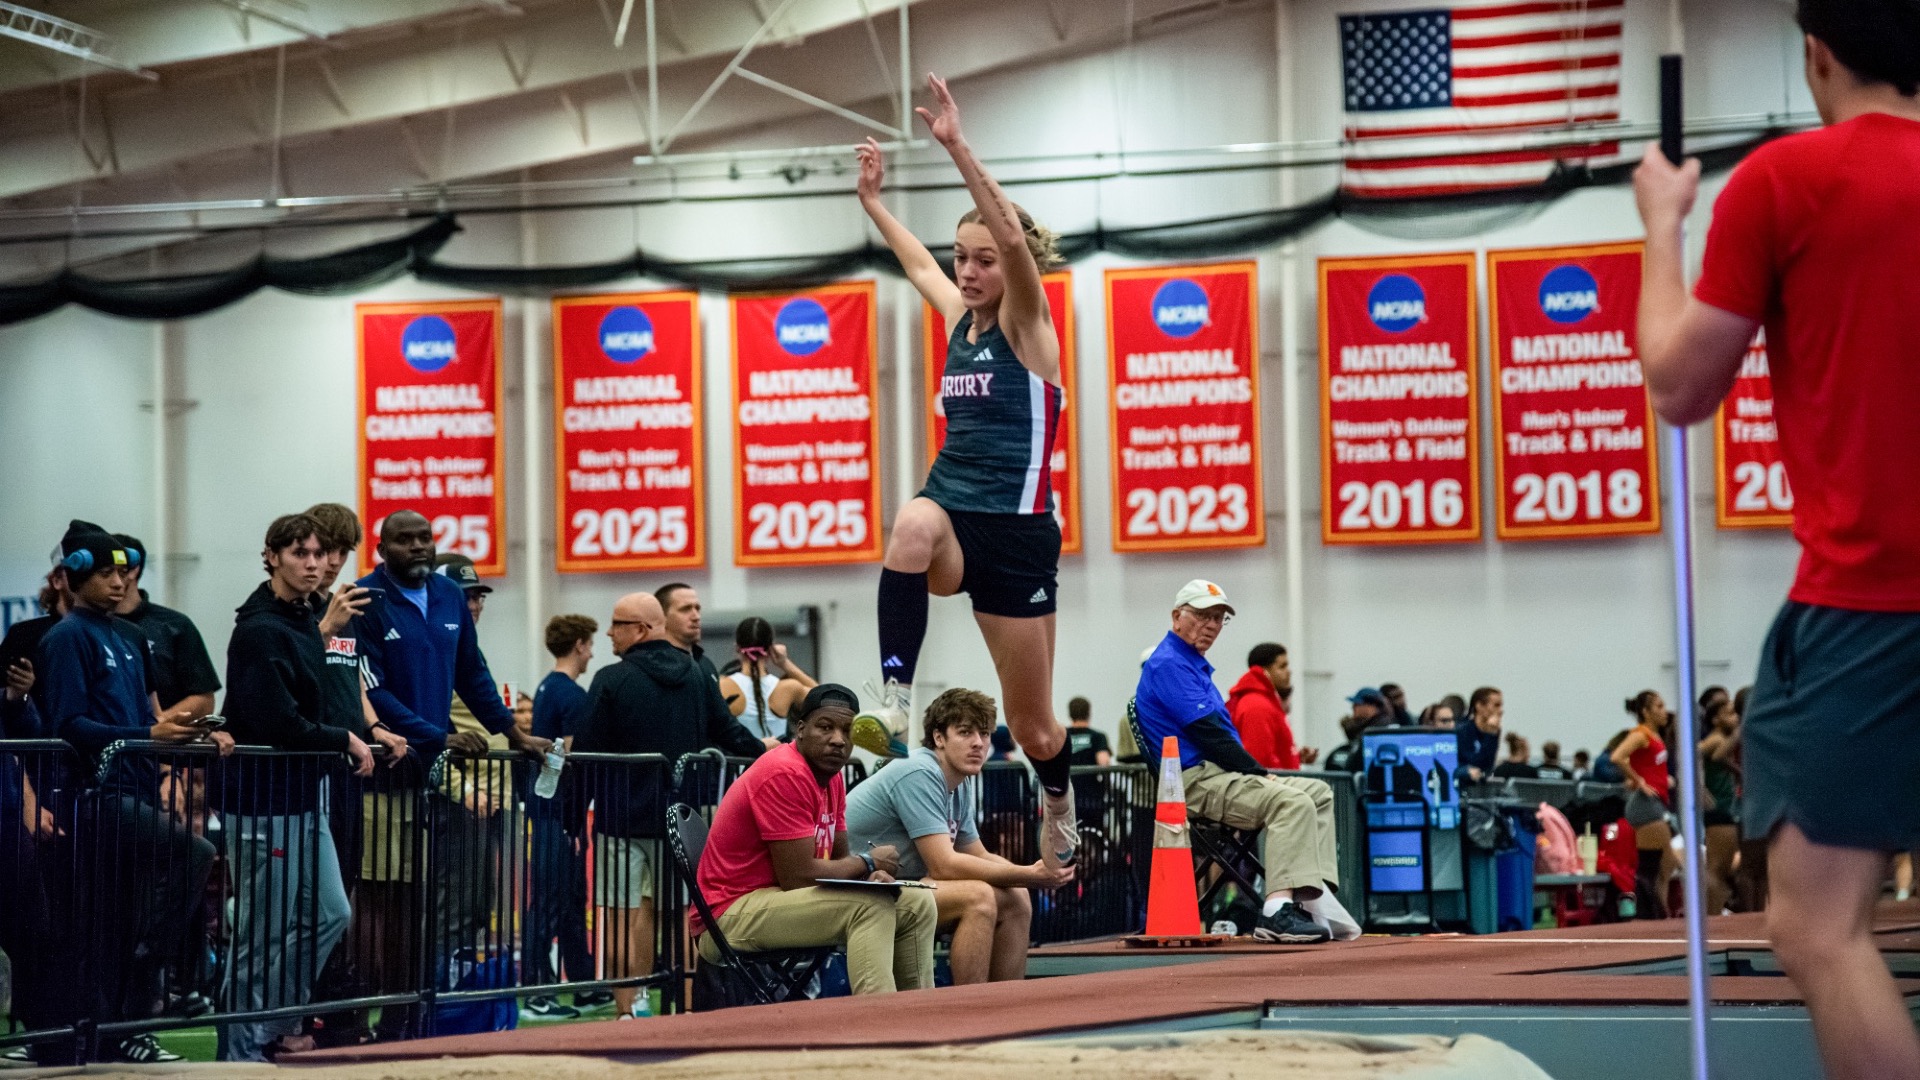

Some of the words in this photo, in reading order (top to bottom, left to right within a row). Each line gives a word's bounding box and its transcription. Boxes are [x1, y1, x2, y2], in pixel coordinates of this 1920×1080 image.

[1341, 343, 1456, 369] NATIONAL
[1512, 331, 1632, 361] NATIONAL
[1126, 349, 1238, 378] NATIONAL
[1501, 357, 1644, 393] CHAMPIONS
[574, 374, 682, 401] NATIONAL
[750, 368, 858, 395] NATIONAL
[1115, 375, 1252, 409] CHAMPIONS
[1330, 369, 1468, 401] CHAMPIONS
[376, 384, 484, 411] NATIONAL
[739, 394, 870, 426] CHAMPIONS
[1737, 398, 1774, 417] Men
[365, 412, 496, 440] CHAMPIONS
[564, 401, 692, 432] CHAMPIONS
[1404, 418, 1467, 436] Outdoor
[1522, 411, 1571, 429] Men's
[1573, 408, 1627, 427] Indoor
[1729, 419, 1778, 442] Trac
[1178, 424, 1240, 443] Outdoor
[1507, 431, 1566, 455] Track
[1570, 430, 1588, 452] &
[1590, 425, 1643, 451] Field
[1123, 447, 1178, 469] Track
[1181, 446, 1198, 467] &
[1202, 443, 1250, 465] Field
[1335, 440, 1390, 463] Track
[1395, 439, 1412, 461] &
[1414, 434, 1465, 460] Field
[424, 457, 485, 474] Outdoor
[569, 469, 621, 491] Track
[624, 469, 641, 489] &
[644, 466, 691, 488] Field
[745, 463, 799, 485] Track
[802, 462, 819, 483] &
[822, 459, 868, 481] Field
[371, 478, 423, 499] Track
[426, 476, 443, 498] &
[446, 476, 493, 497] Field
[1513, 469, 1642, 521] 2018
[1734, 462, 1794, 511] 20
[1128, 484, 1248, 535] 2023
[1339, 479, 1463, 528] 2016
[572, 506, 688, 555] 2025
[750, 500, 866, 549] 2025
